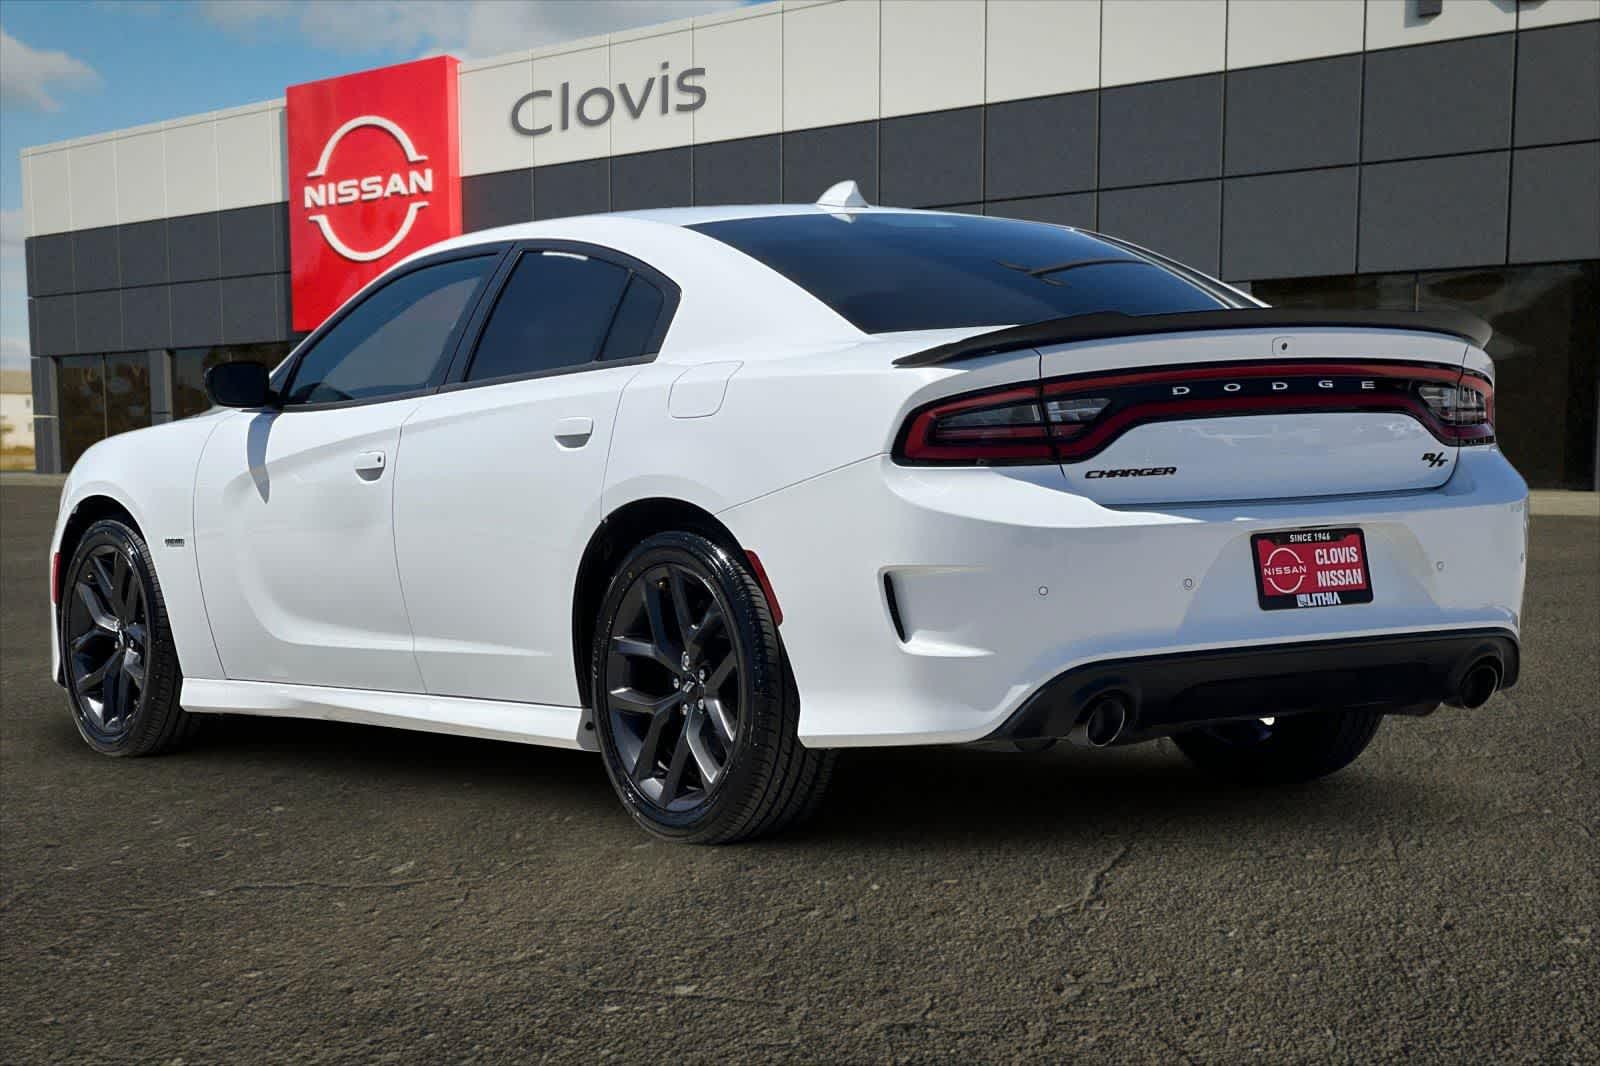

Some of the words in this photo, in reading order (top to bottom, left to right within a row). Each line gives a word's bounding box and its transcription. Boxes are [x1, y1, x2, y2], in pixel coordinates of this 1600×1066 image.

[511, 61, 707, 136] Clovis
[303, 168, 433, 208] NISSAN
[1172, 380, 1376, 395] DODGE
[1085, 466, 1177, 479] CHARGER
[1289, 533, 1312, 543] SINCE
[1315, 546, 1358, 565] CLOVIS
[1263, 565, 1307, 576] NISSAN
[1317, 568, 1363, 587] NISSAN
[1306, 591, 1342, 606] LITHIA
